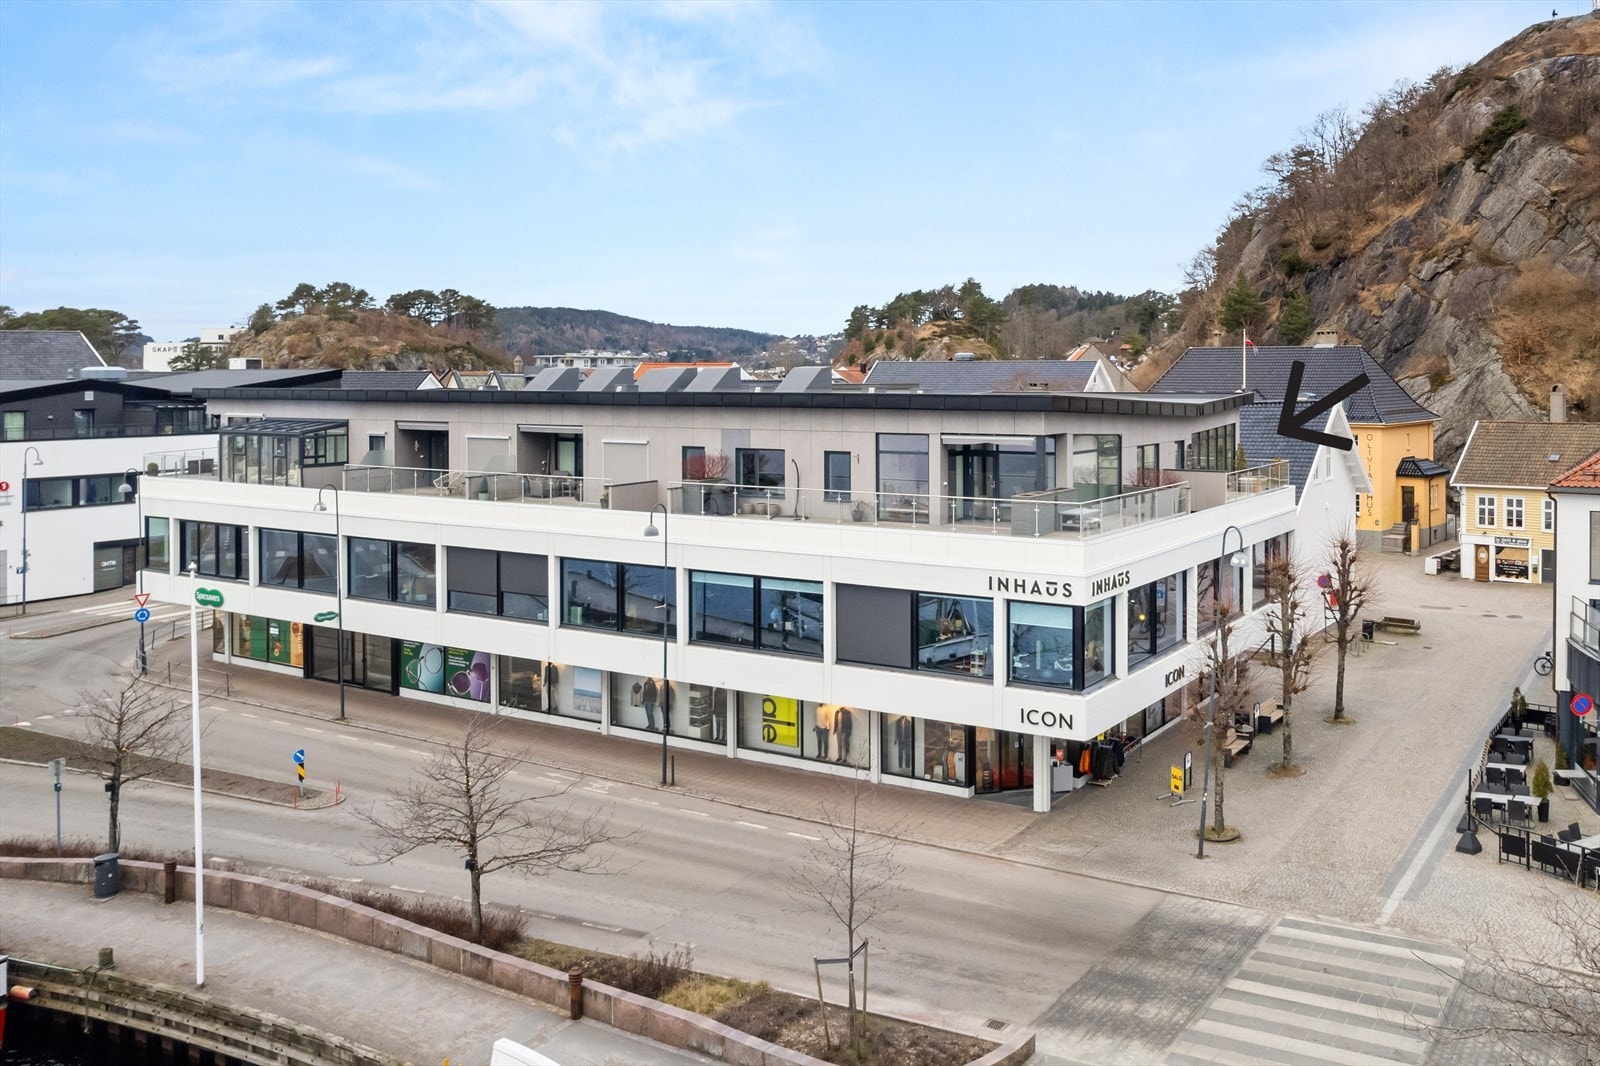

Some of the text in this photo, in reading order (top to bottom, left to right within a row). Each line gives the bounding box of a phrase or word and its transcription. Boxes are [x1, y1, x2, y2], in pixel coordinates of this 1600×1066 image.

[1165, 664, 1185, 688] ICON
[762, 695, 796, 744] ale
[1020, 708, 1073, 730] ICON
